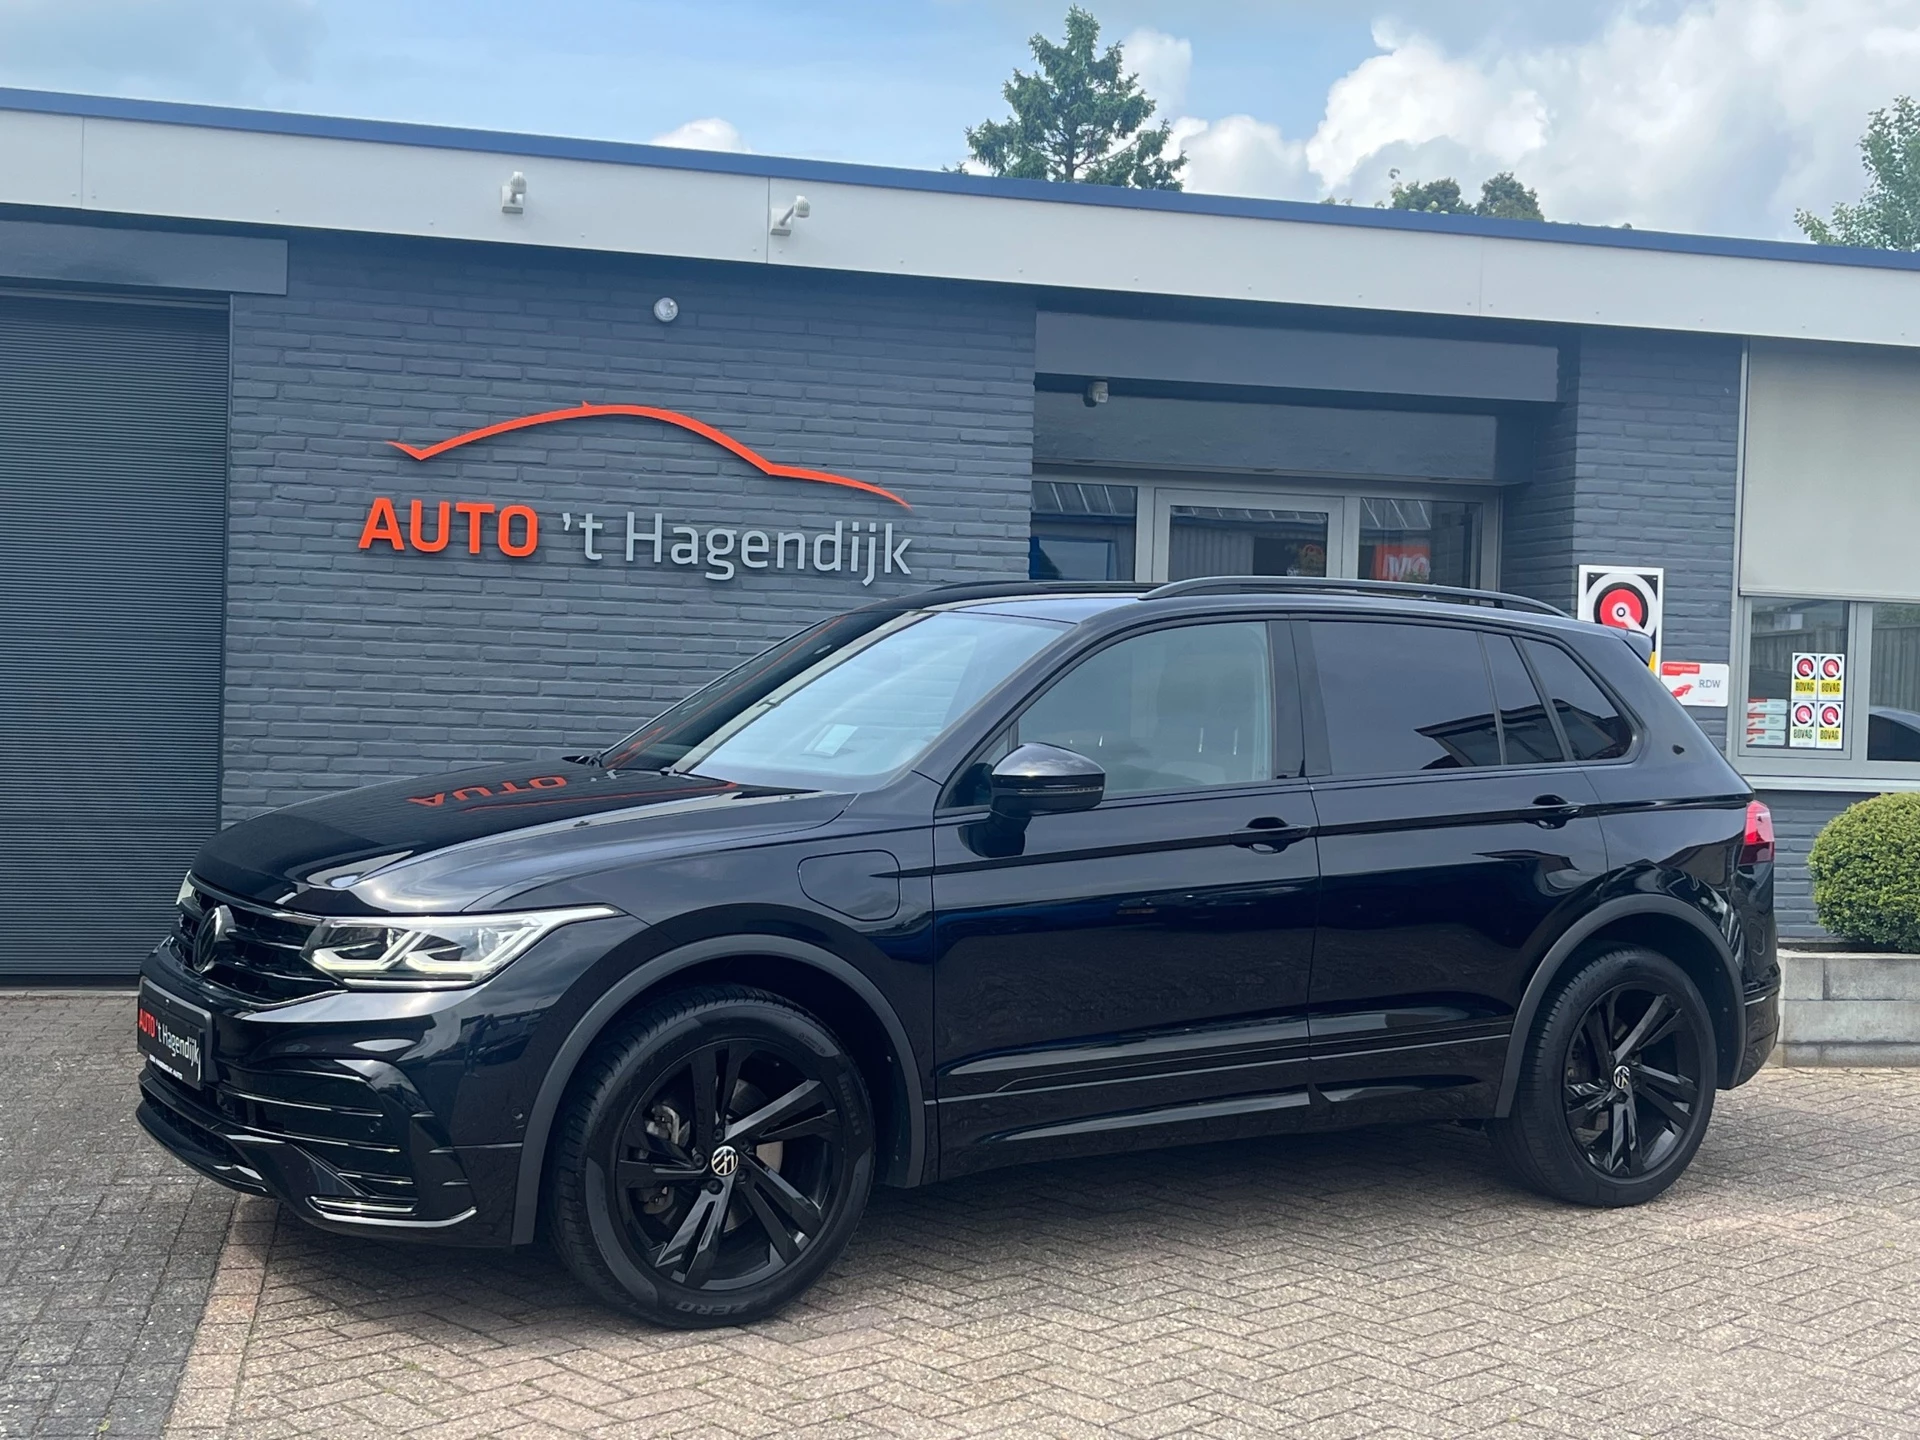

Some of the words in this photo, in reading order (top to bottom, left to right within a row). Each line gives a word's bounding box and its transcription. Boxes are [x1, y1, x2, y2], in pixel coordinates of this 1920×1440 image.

[358, 497, 538, 557] AUTO
[626, 511, 912, 587] Hagendijk
[1698, 679, 1721, 688] RDW
[1795, 681, 1815, 693] BOVAG
[1821, 682, 1841, 693] BOVAG
[1793, 729, 1813, 739] BOVAG
[1820, 729, 1839, 740] BOVAG
[139, 1008, 156, 1038] AUTO
[162, 1023, 200, 1067] Hagendijk
